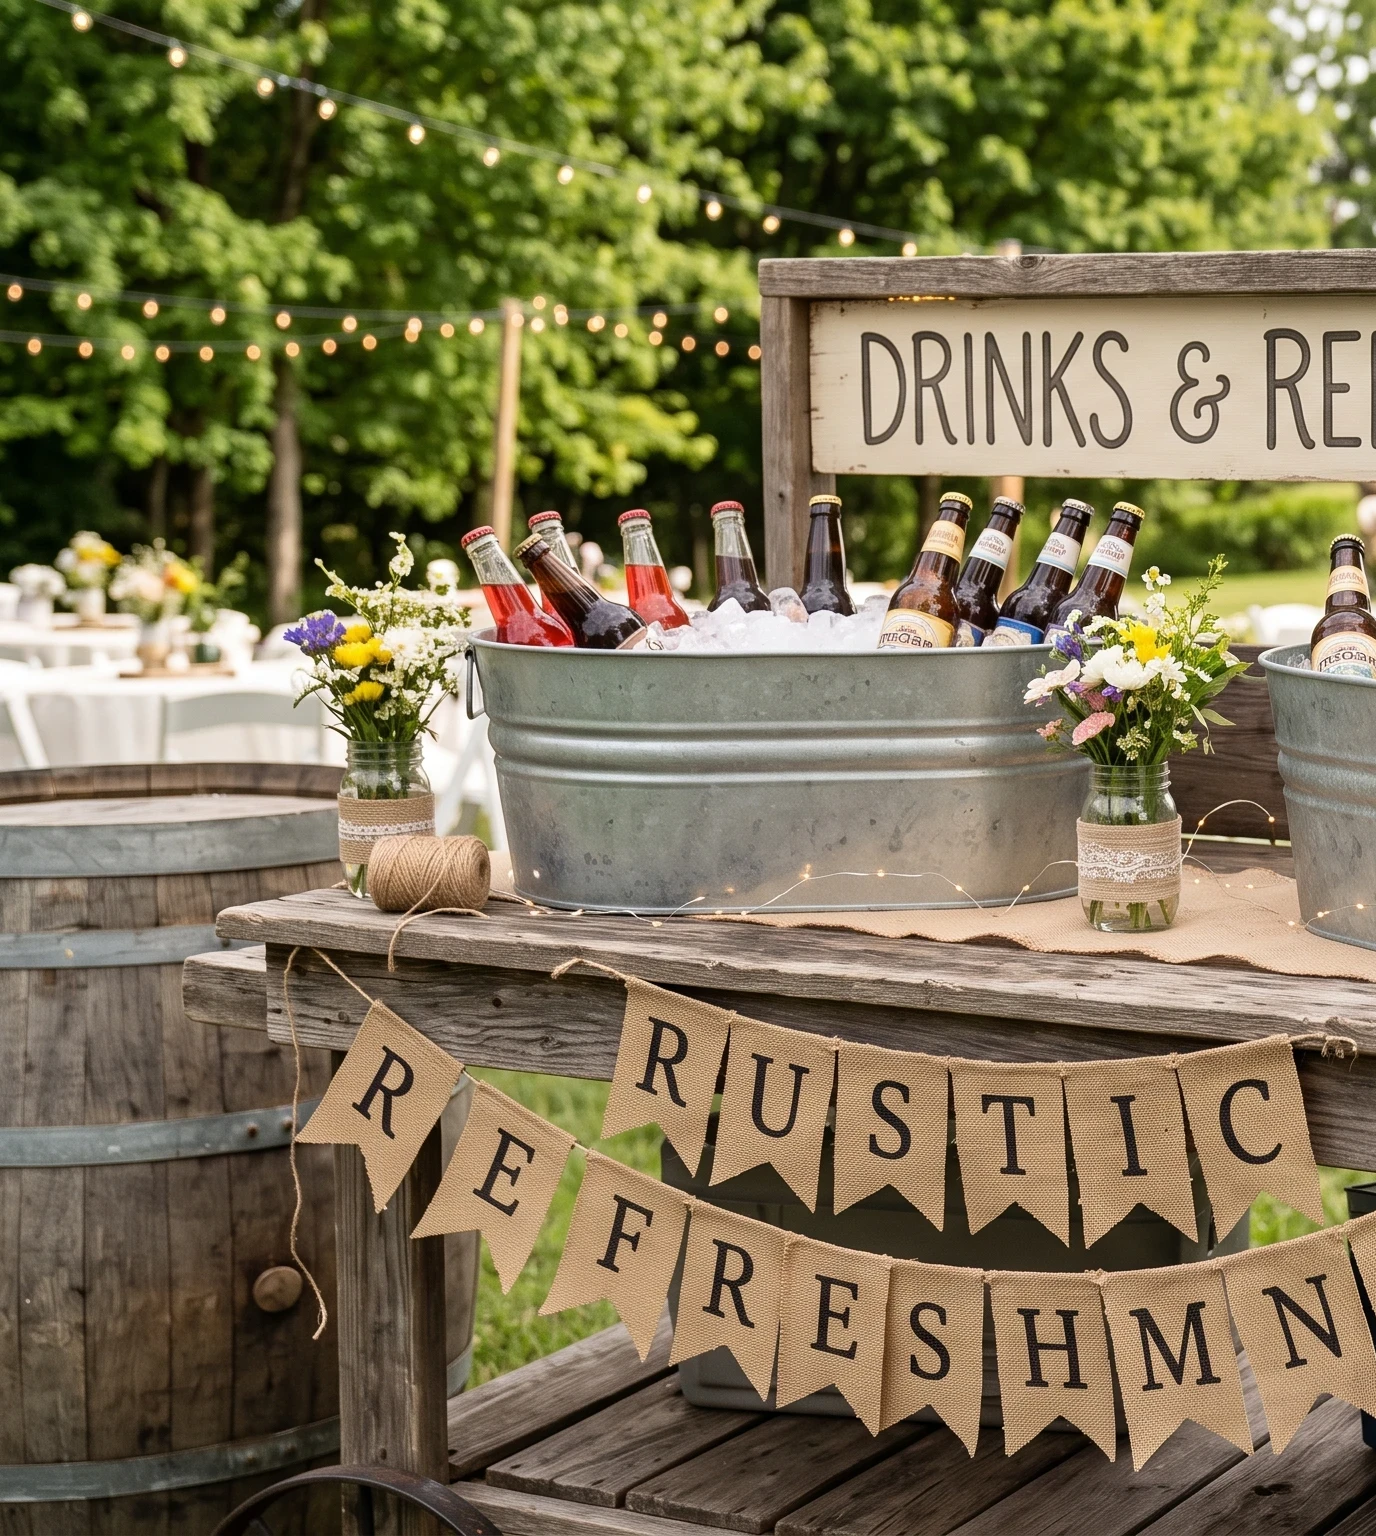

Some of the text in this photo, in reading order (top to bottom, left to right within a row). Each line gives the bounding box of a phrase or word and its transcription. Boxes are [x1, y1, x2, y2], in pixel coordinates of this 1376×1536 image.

[861, 329, 1133, 450] DRINKS
[1169, 340, 1231, 445] &
[635, 1016, 1283, 1177] RUSTIC
